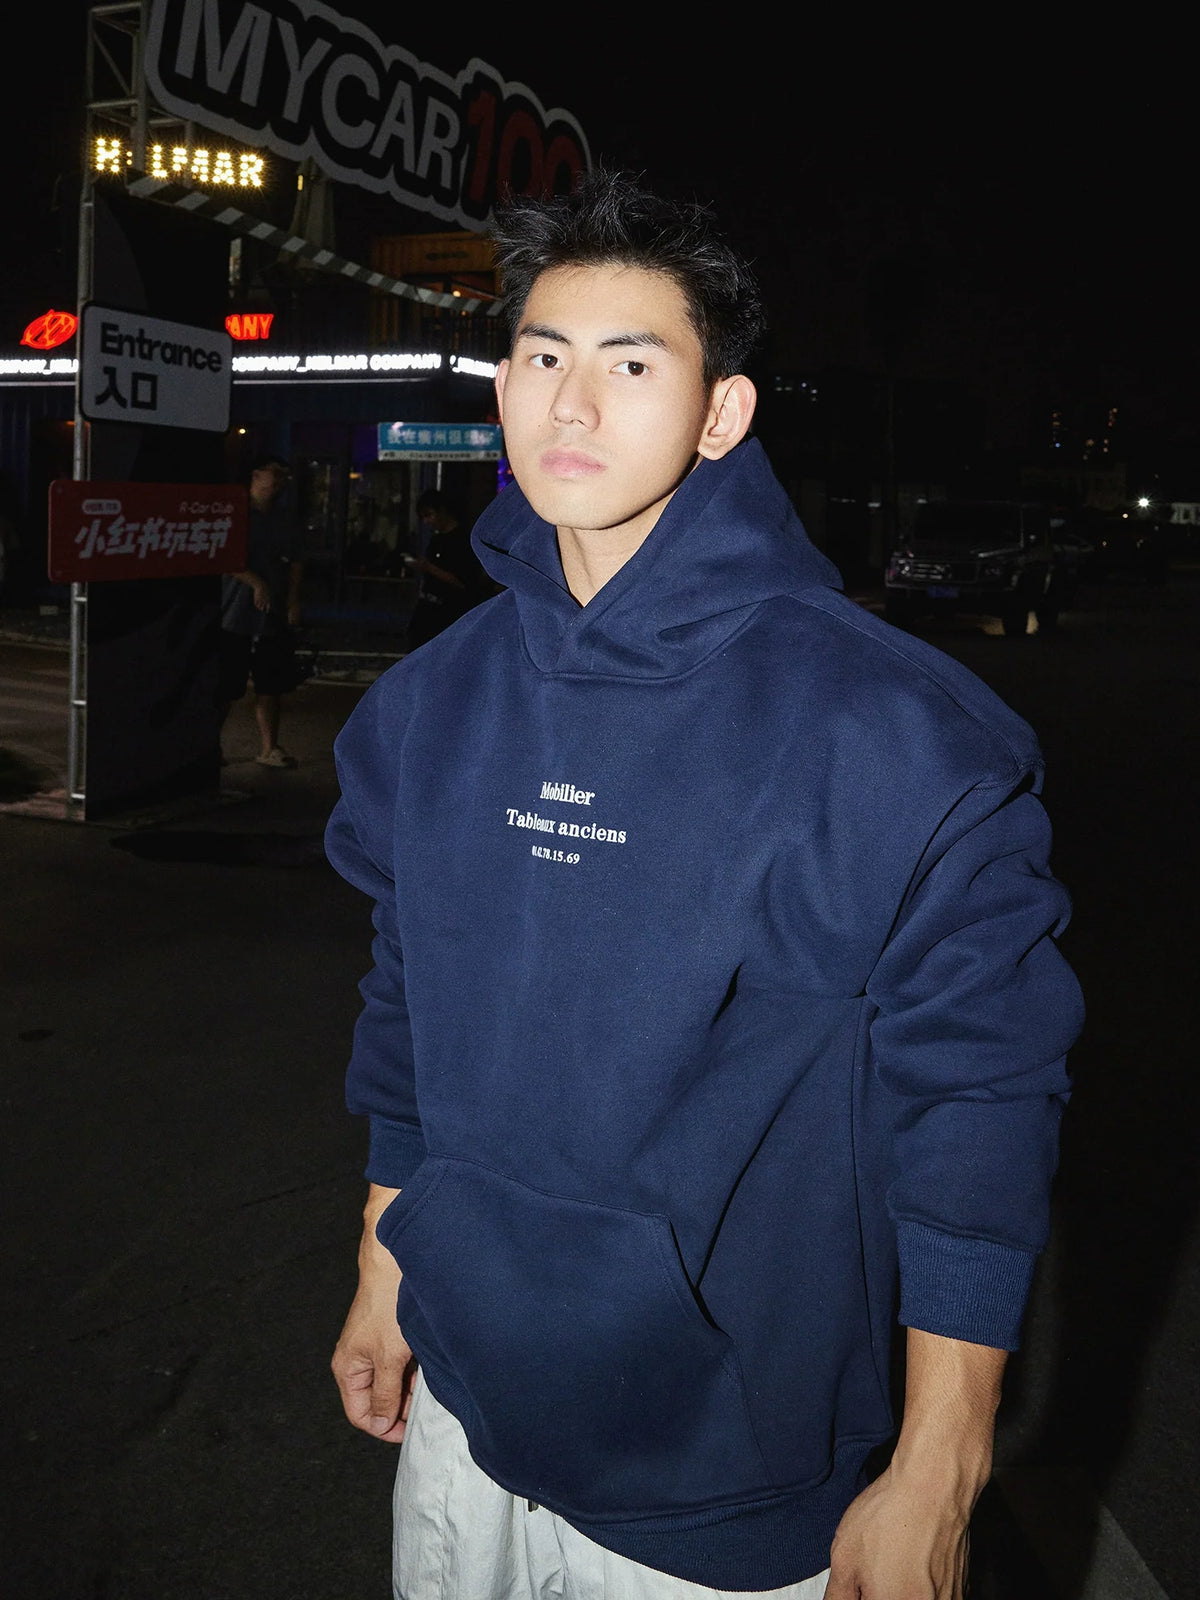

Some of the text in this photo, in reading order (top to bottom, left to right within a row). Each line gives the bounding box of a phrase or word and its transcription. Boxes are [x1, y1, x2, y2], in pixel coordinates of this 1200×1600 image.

[225, 313, 273, 340] ANY
[101, 322, 222, 373] Entrance
[369, 353, 440, 370] COMPANY
[95, 366, 157, 410] 入口
[74, 514, 232, 559] 小红书玩车节
[540, 781, 595, 805] Mobilier
[557, 822, 627, 843] anciens
